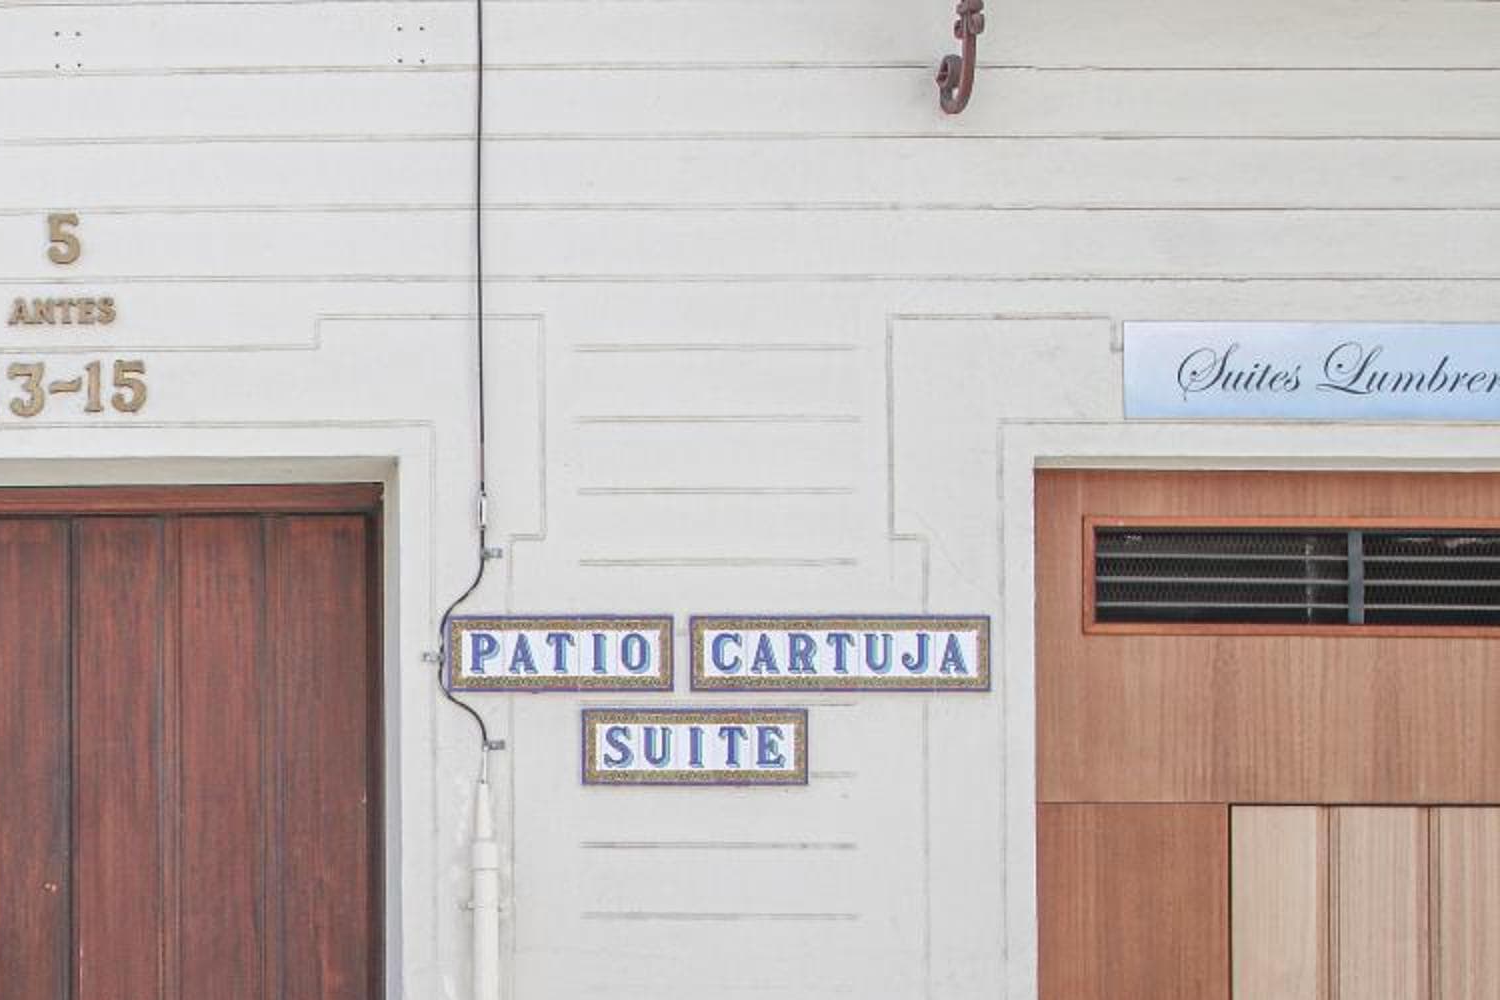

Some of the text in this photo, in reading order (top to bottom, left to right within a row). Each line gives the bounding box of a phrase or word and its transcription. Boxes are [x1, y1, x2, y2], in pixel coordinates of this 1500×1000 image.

[47, 213, 81, 264] 5
[8, 297, 117, 325] ANTES
[1177, 343, 1301, 401] Suites
[469, 632, 969, 674] PATIO CARTUJA
[603, 726, 785, 768] SUITE
